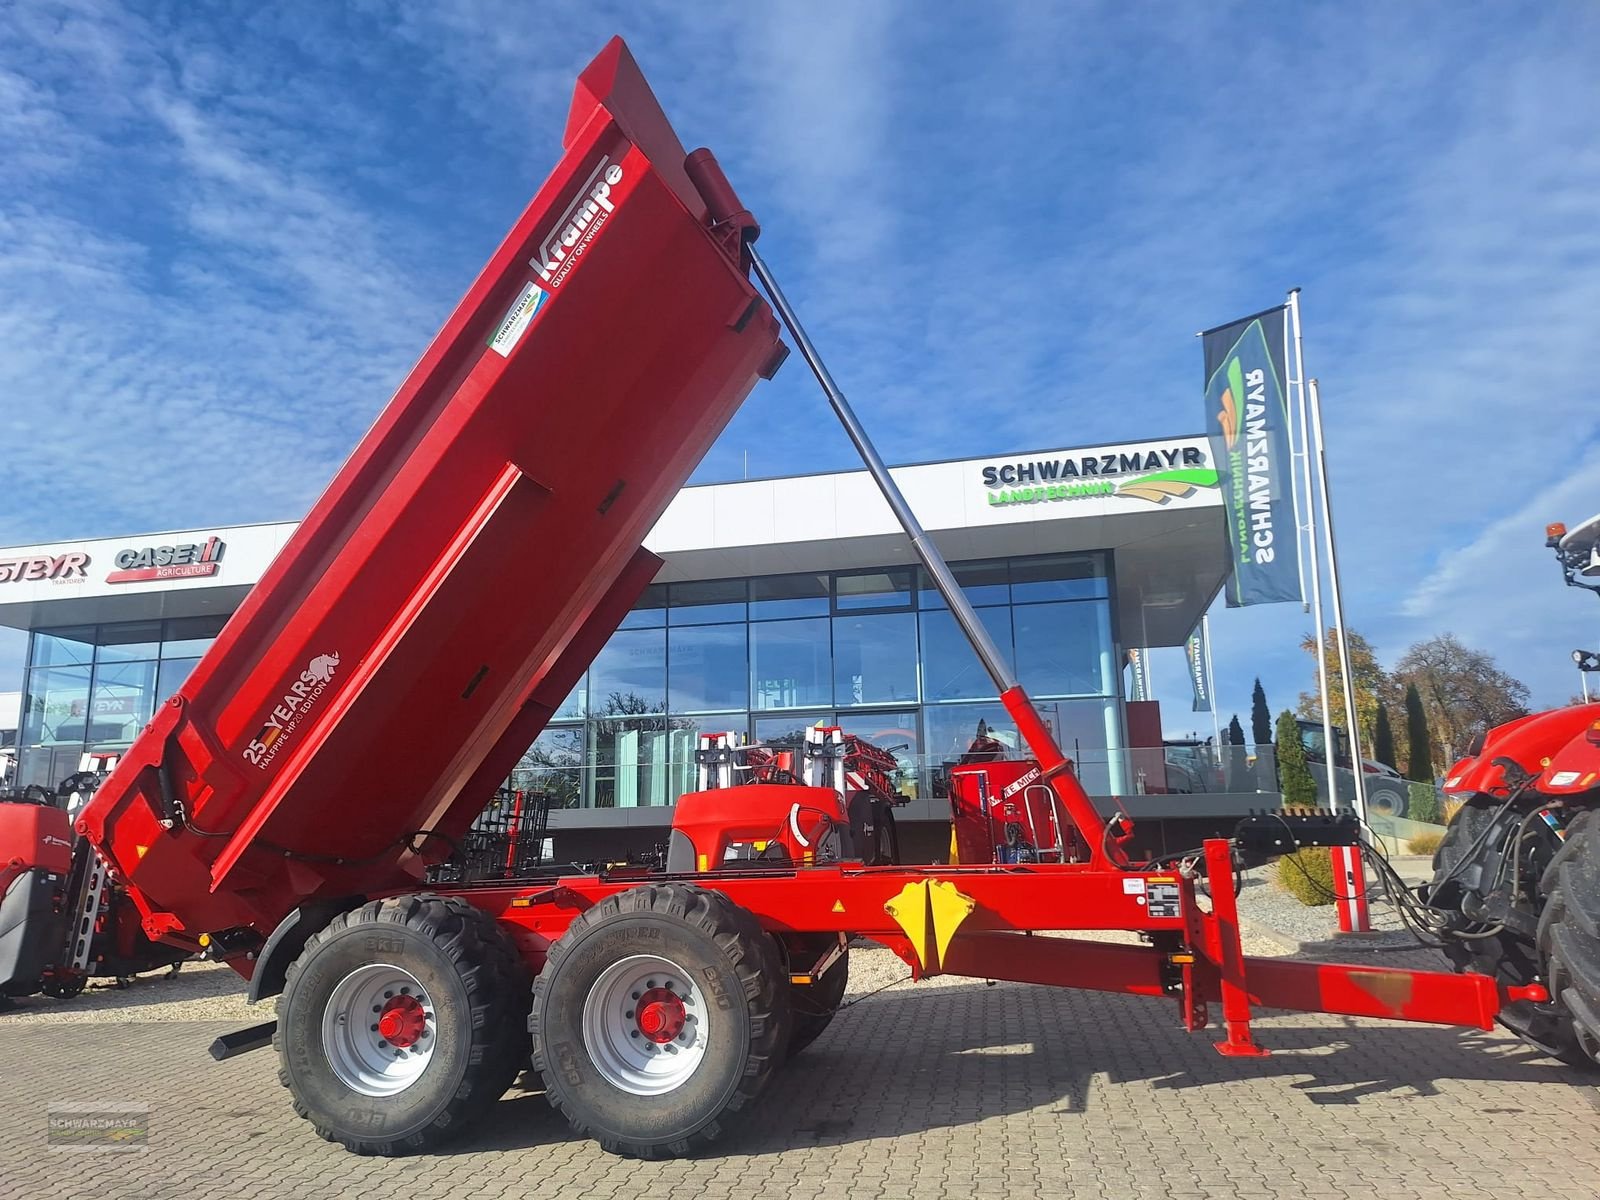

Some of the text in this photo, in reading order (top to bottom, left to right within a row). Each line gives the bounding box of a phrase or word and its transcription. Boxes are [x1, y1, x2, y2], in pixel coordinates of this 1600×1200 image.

[552, 211, 610, 289] QUALITY ON WHEELS
[495, 293, 532, 344] SCHWARZMAYR
[982, 446, 1202, 487] SCHWARZMAYR
[987, 481, 1115, 506] LANDTECHNIK
[114, 544, 194, 569] CASE
[156, 565, 213, 578] AGRICULTURE
[242, 669, 319, 766] 25 YEARS
[258, 681, 328, 770] HALFPIPE HP20 EDITION
[1016, 767, 1041, 788] MICH
[702, 966, 731, 1011] BKT
